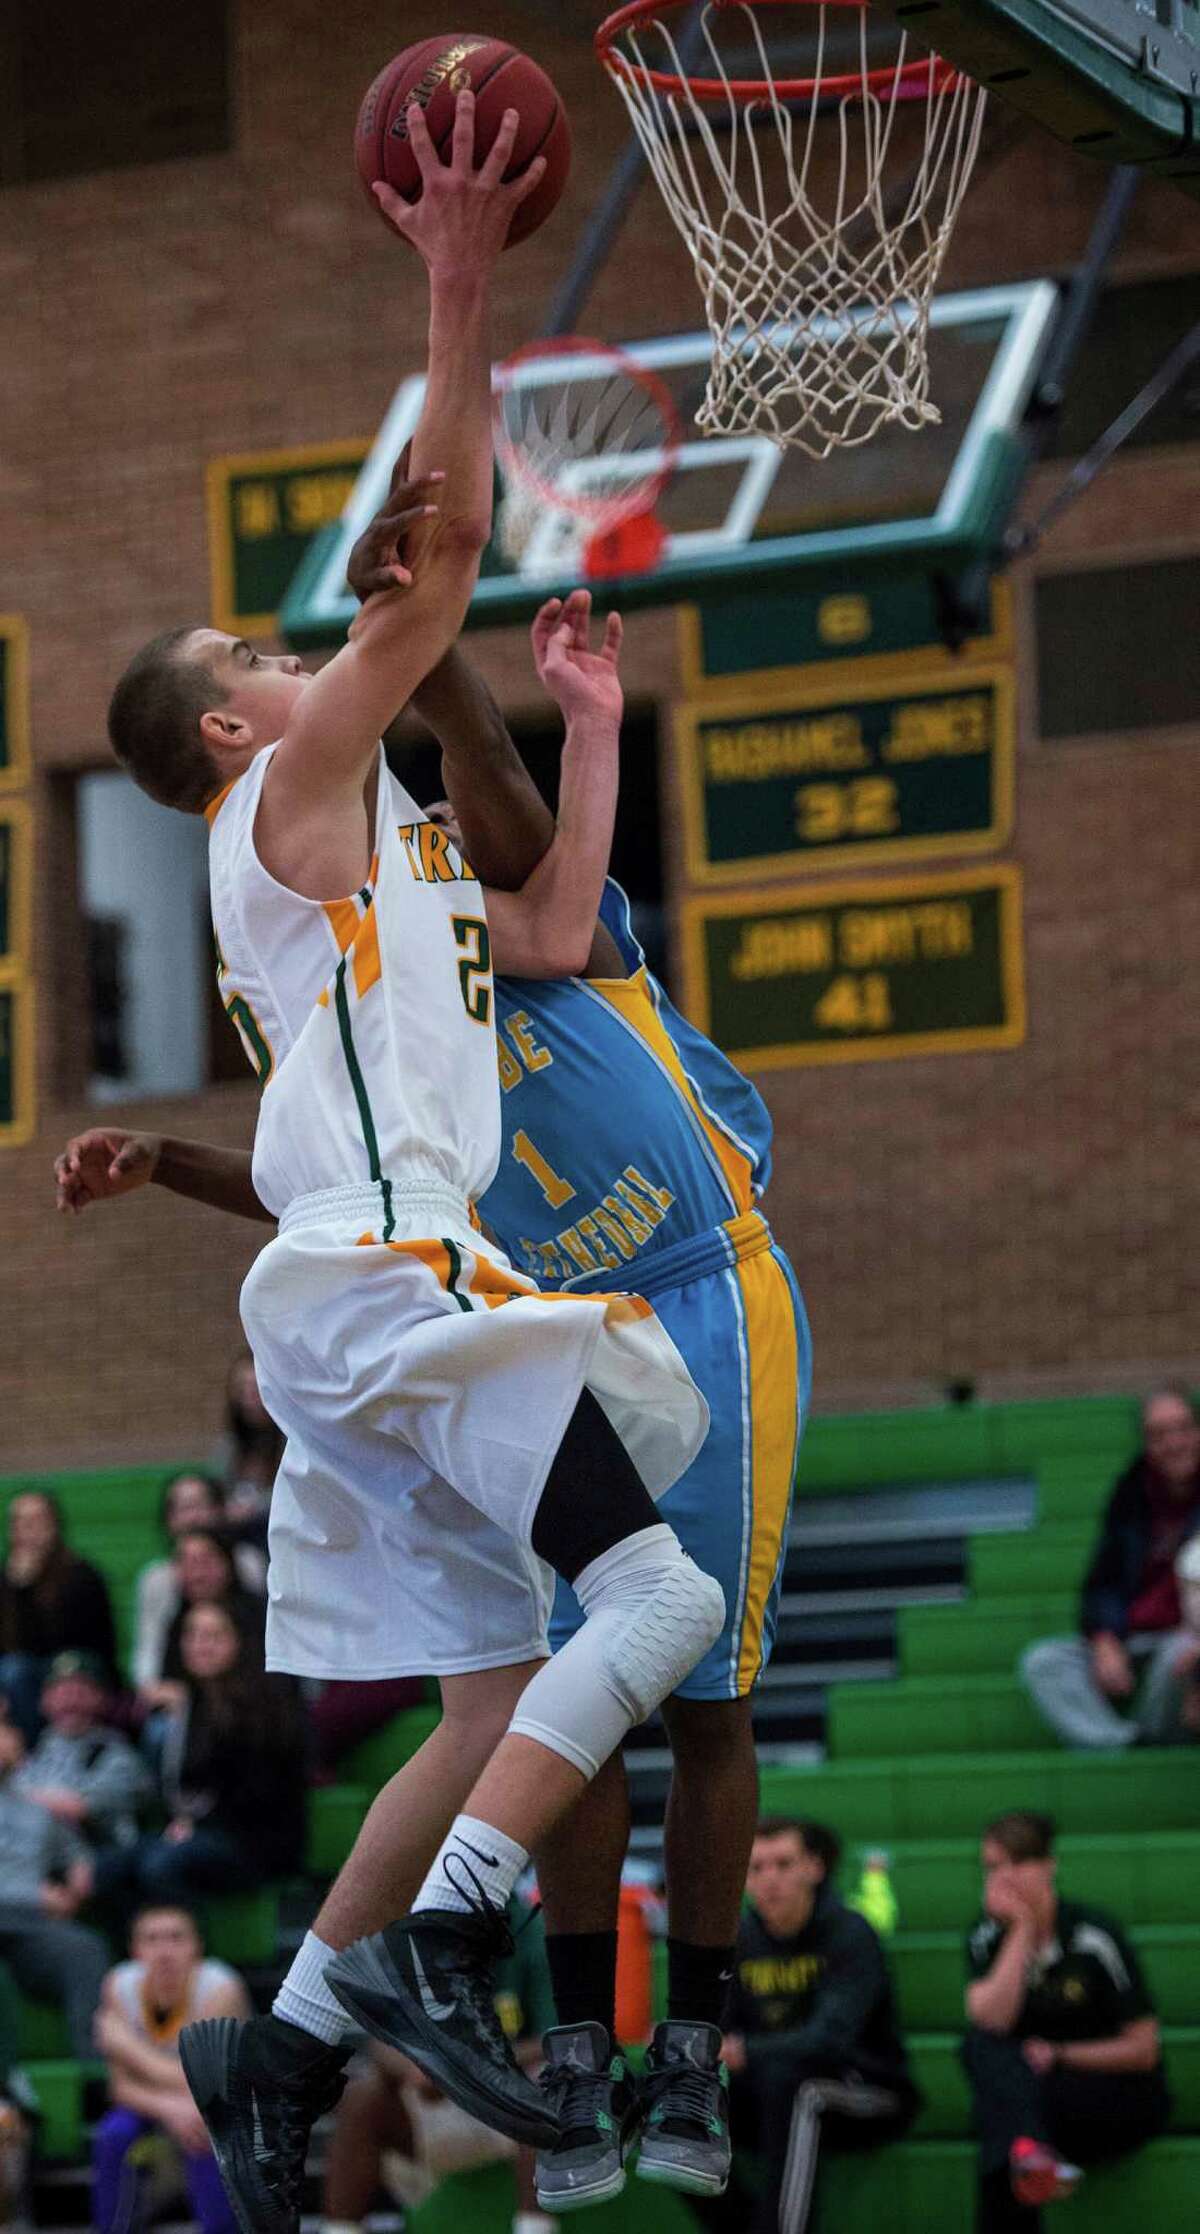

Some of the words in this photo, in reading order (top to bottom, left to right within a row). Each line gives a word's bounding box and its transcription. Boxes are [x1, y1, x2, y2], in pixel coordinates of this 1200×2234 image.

[796, 776, 898, 840] 32
[730, 914, 832, 979] JOHN
[813, 974, 891, 1029] 41
[511, 1129, 577, 1210] 1
